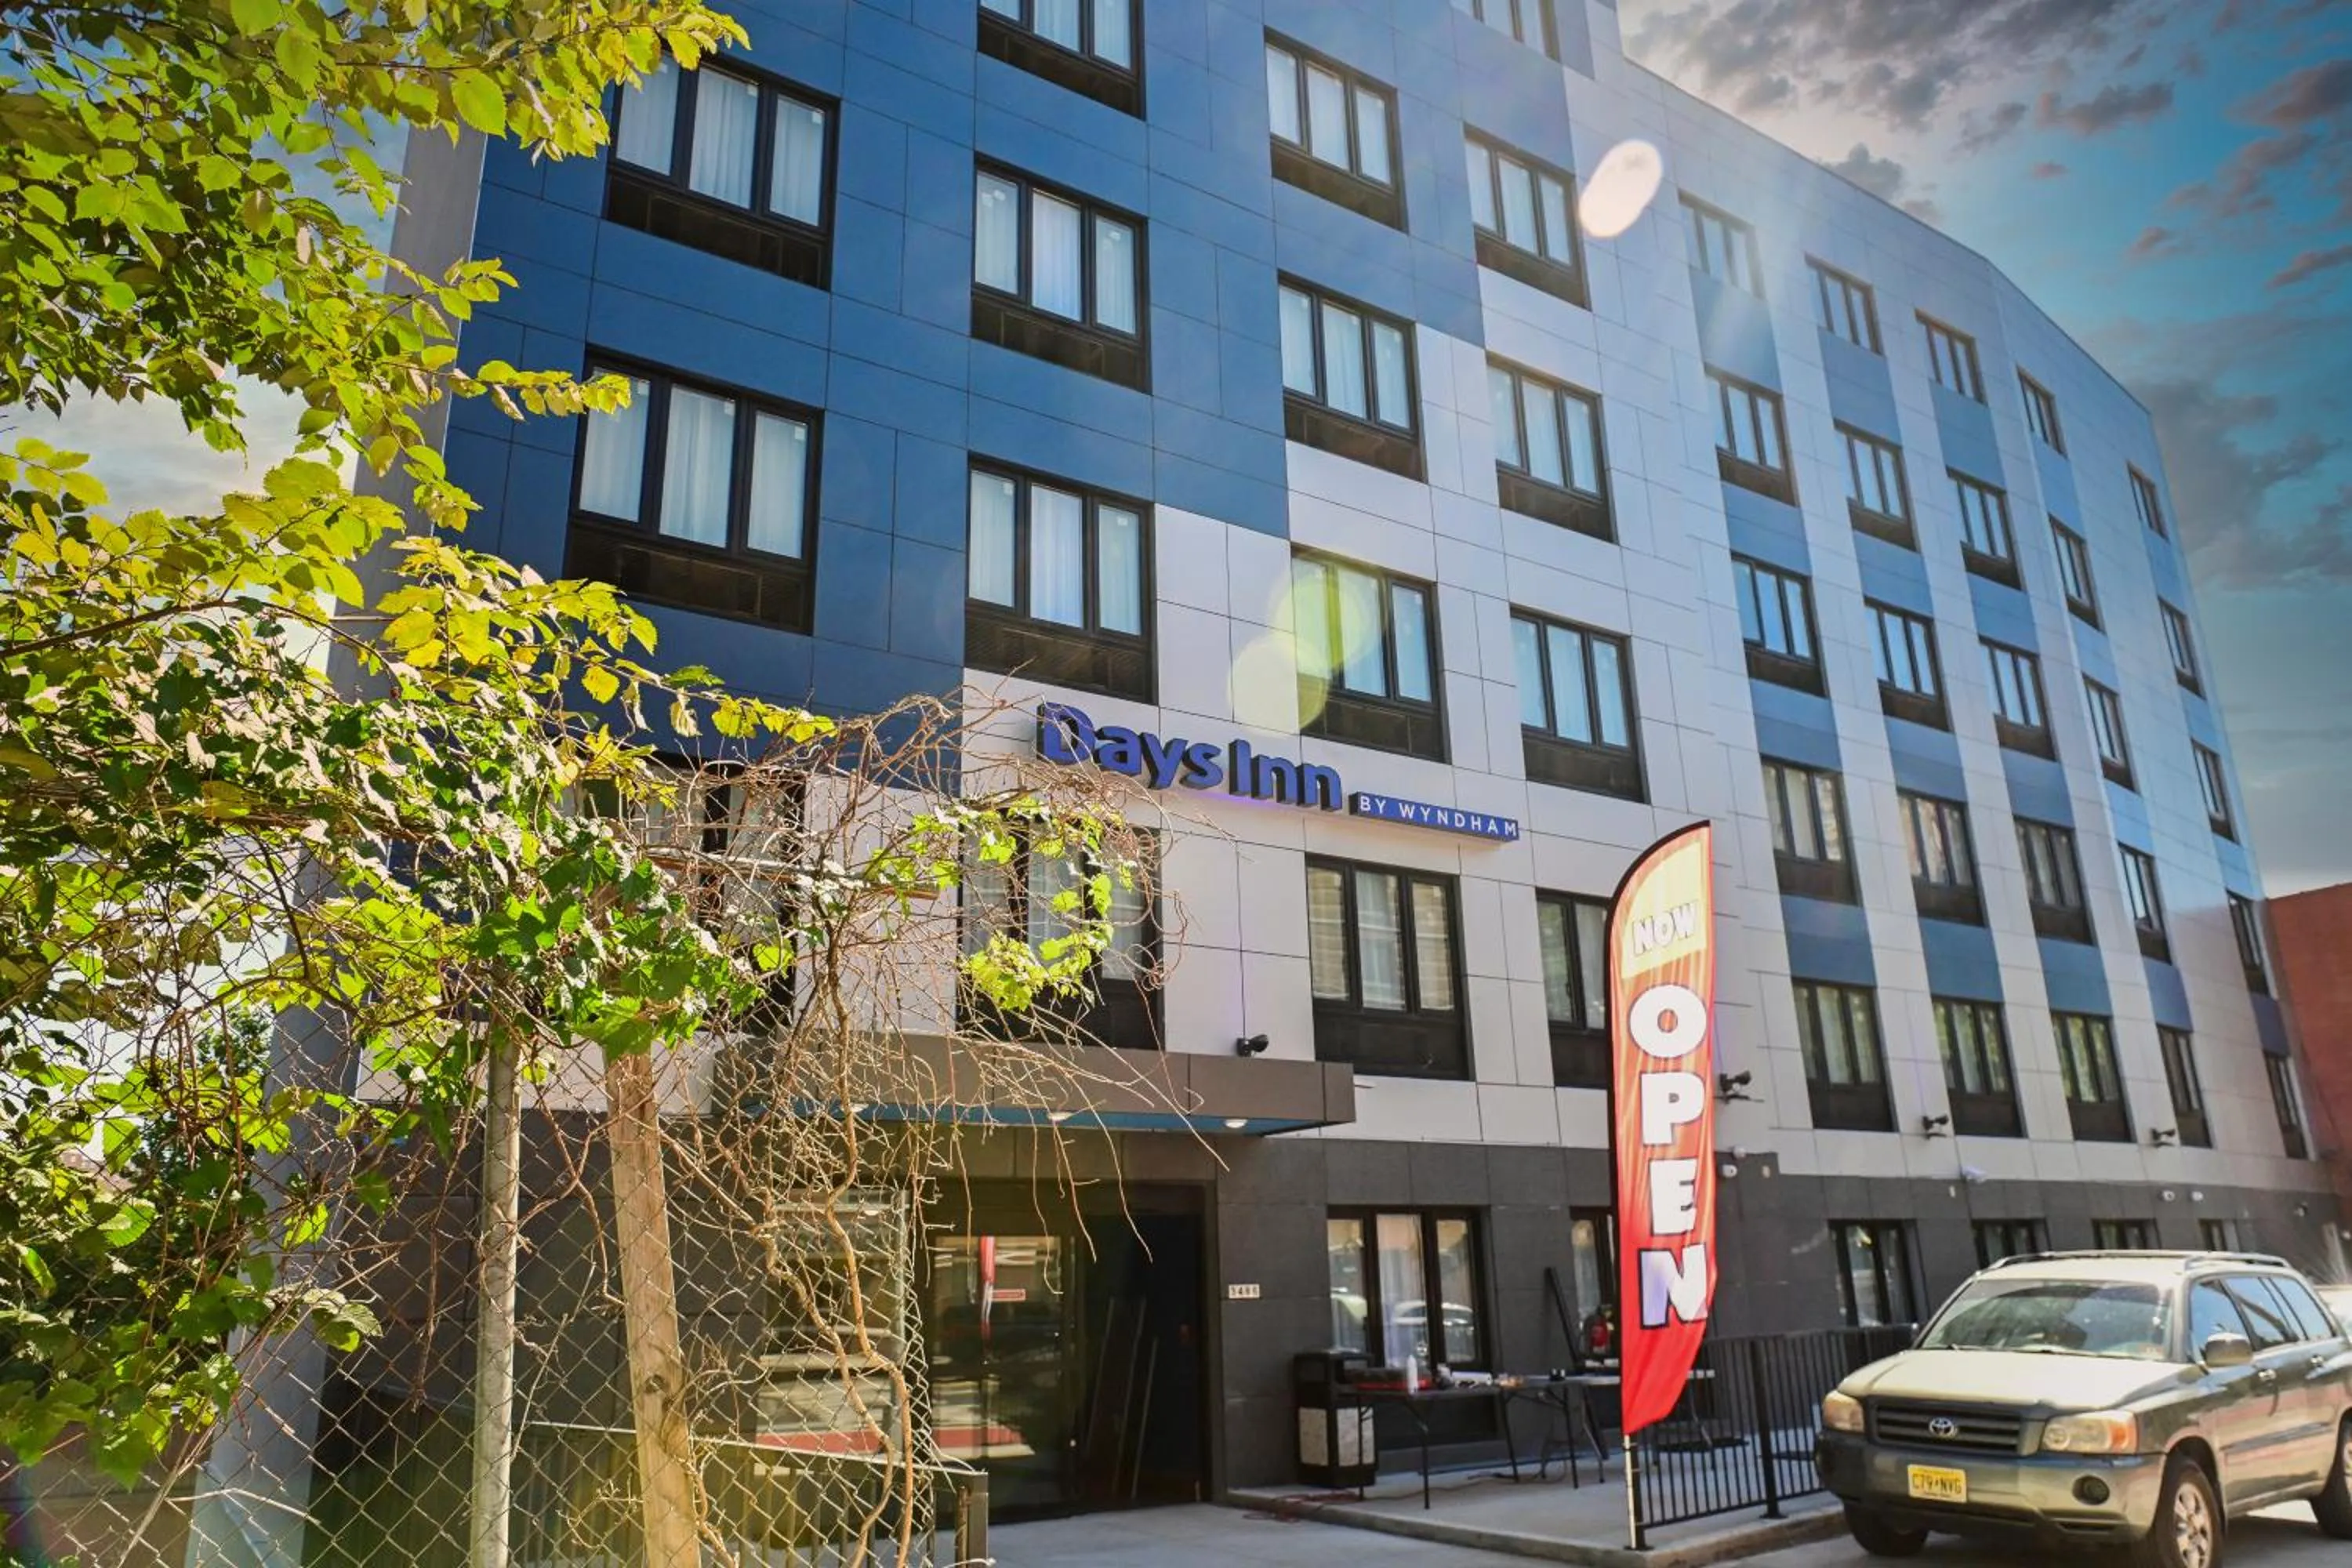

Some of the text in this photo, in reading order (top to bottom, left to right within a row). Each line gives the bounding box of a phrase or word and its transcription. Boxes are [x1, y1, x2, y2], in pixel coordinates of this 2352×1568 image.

[1036, 702, 1342, 811] Days Inn
[1359, 795, 1517, 837] BY WYNDHAM
[1632, 899, 1699, 957] NOW
[1628, 982, 1708, 1330] OPEN
